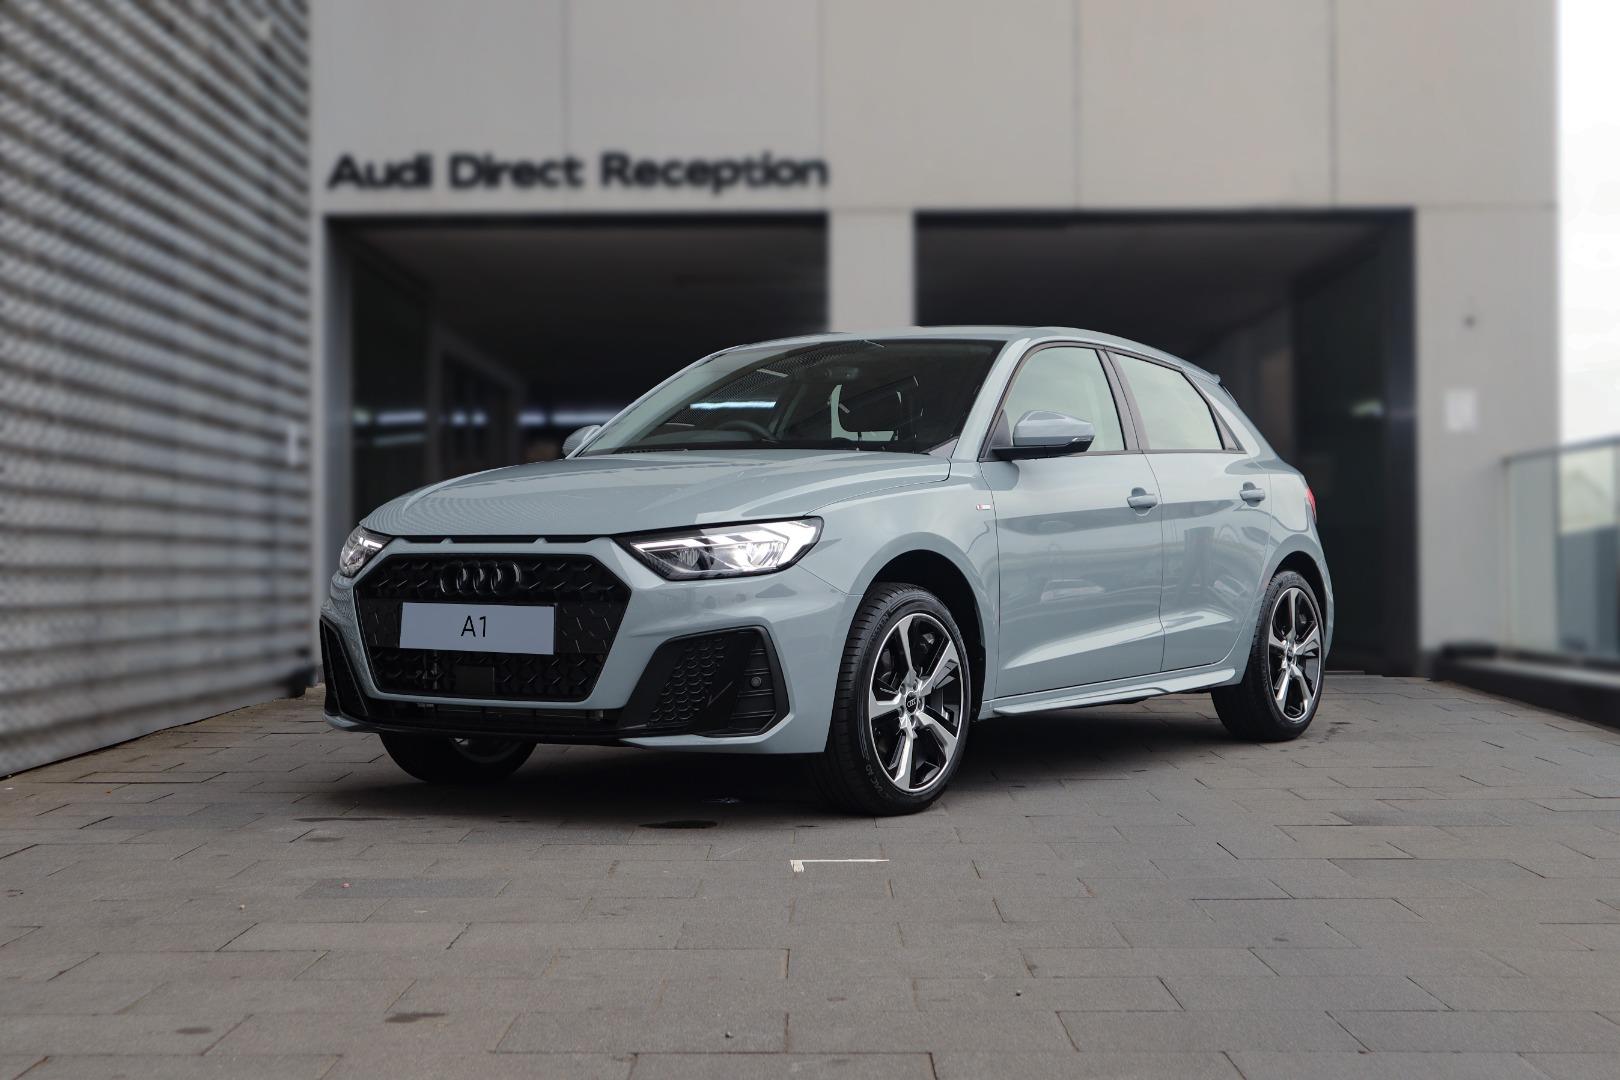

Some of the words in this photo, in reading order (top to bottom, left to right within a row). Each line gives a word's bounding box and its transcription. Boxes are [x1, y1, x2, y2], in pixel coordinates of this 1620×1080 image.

[325, 153, 434, 190] Audi
[447, 153, 584, 190] Direct
[599, 151, 829, 196] Reception
[460, 615, 487, 637] A1
